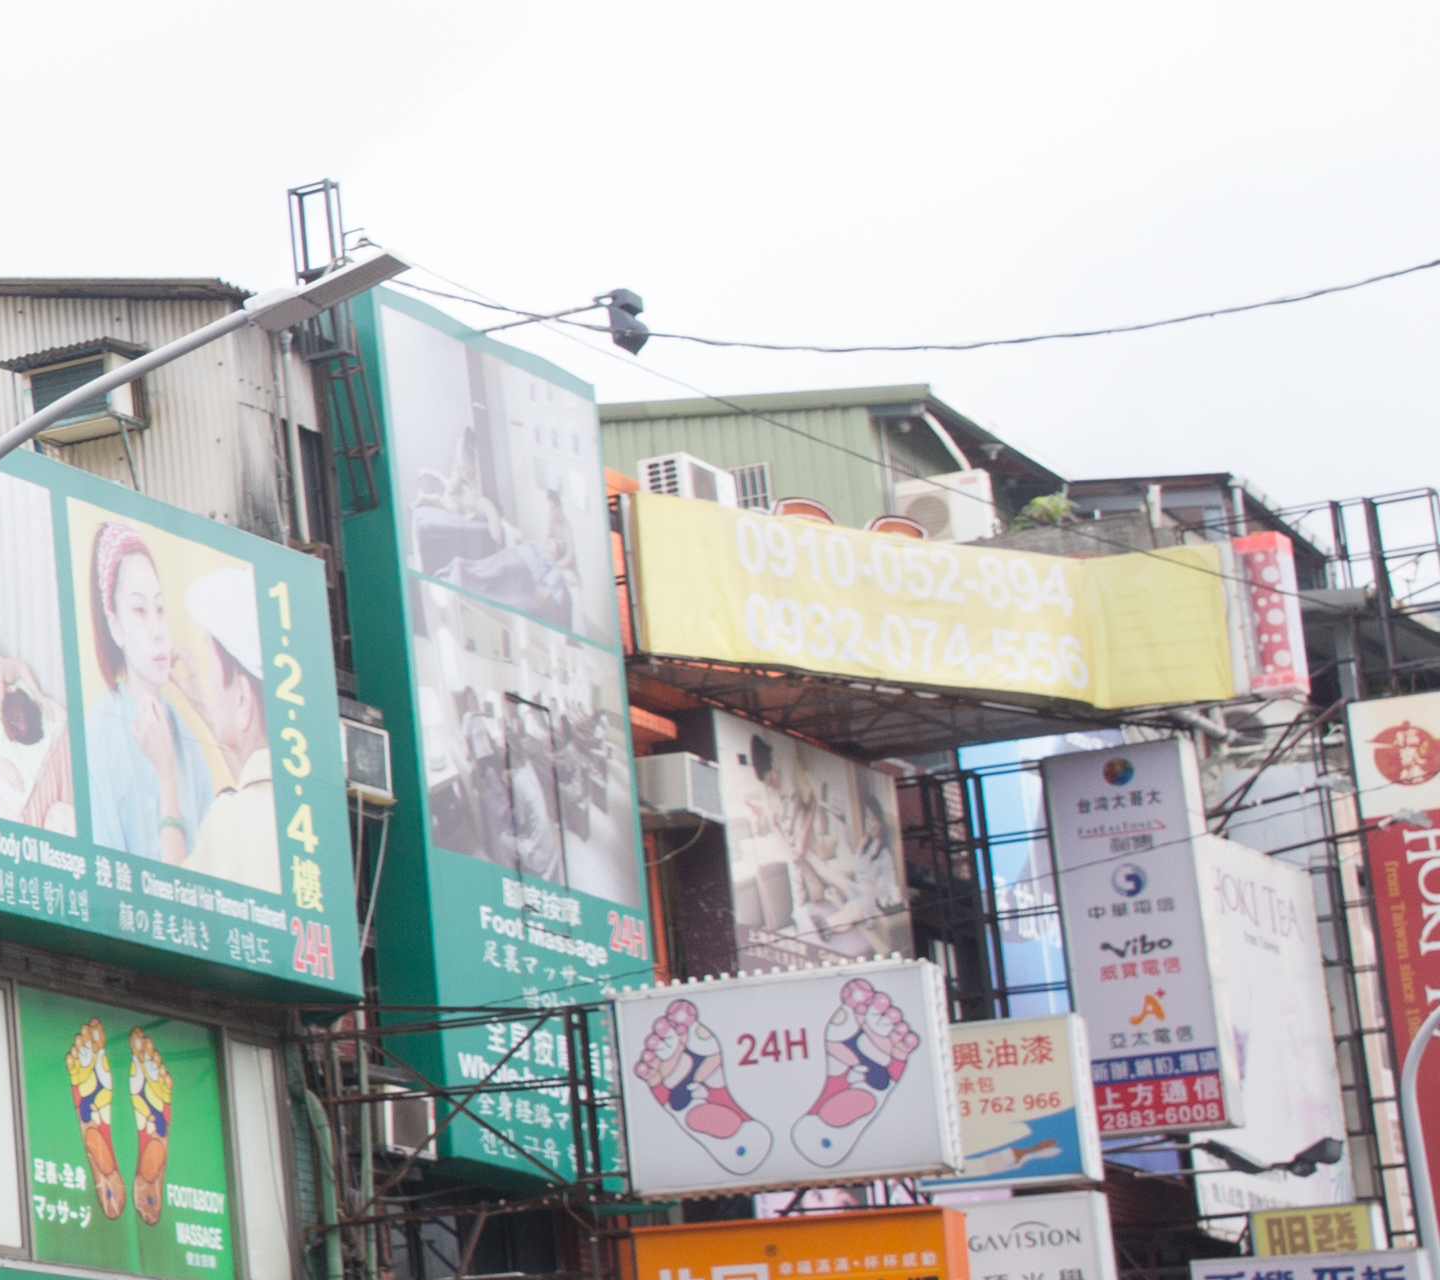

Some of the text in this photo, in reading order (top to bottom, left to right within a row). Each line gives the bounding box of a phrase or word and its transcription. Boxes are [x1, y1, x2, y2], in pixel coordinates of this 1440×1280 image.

[736, 516, 1075, 619] 0910-052-894
[745, 592, 1089, 692] 0932-074-556
[290, 918, 335, 980] 24H
[737, 1027, 810, 1067] 24H
[953, 1034, 1055, 1072] 興油漆
[979, 1091, 1061, 1114] 762 966
[1098, 1076, 1220, 1112] 上方通信
[1102, 1102, 1221, 1131] 2883-6008
[33, 1195, 91, 1228] マッサージ
[175, 1222, 223, 1250] MASSAGE
